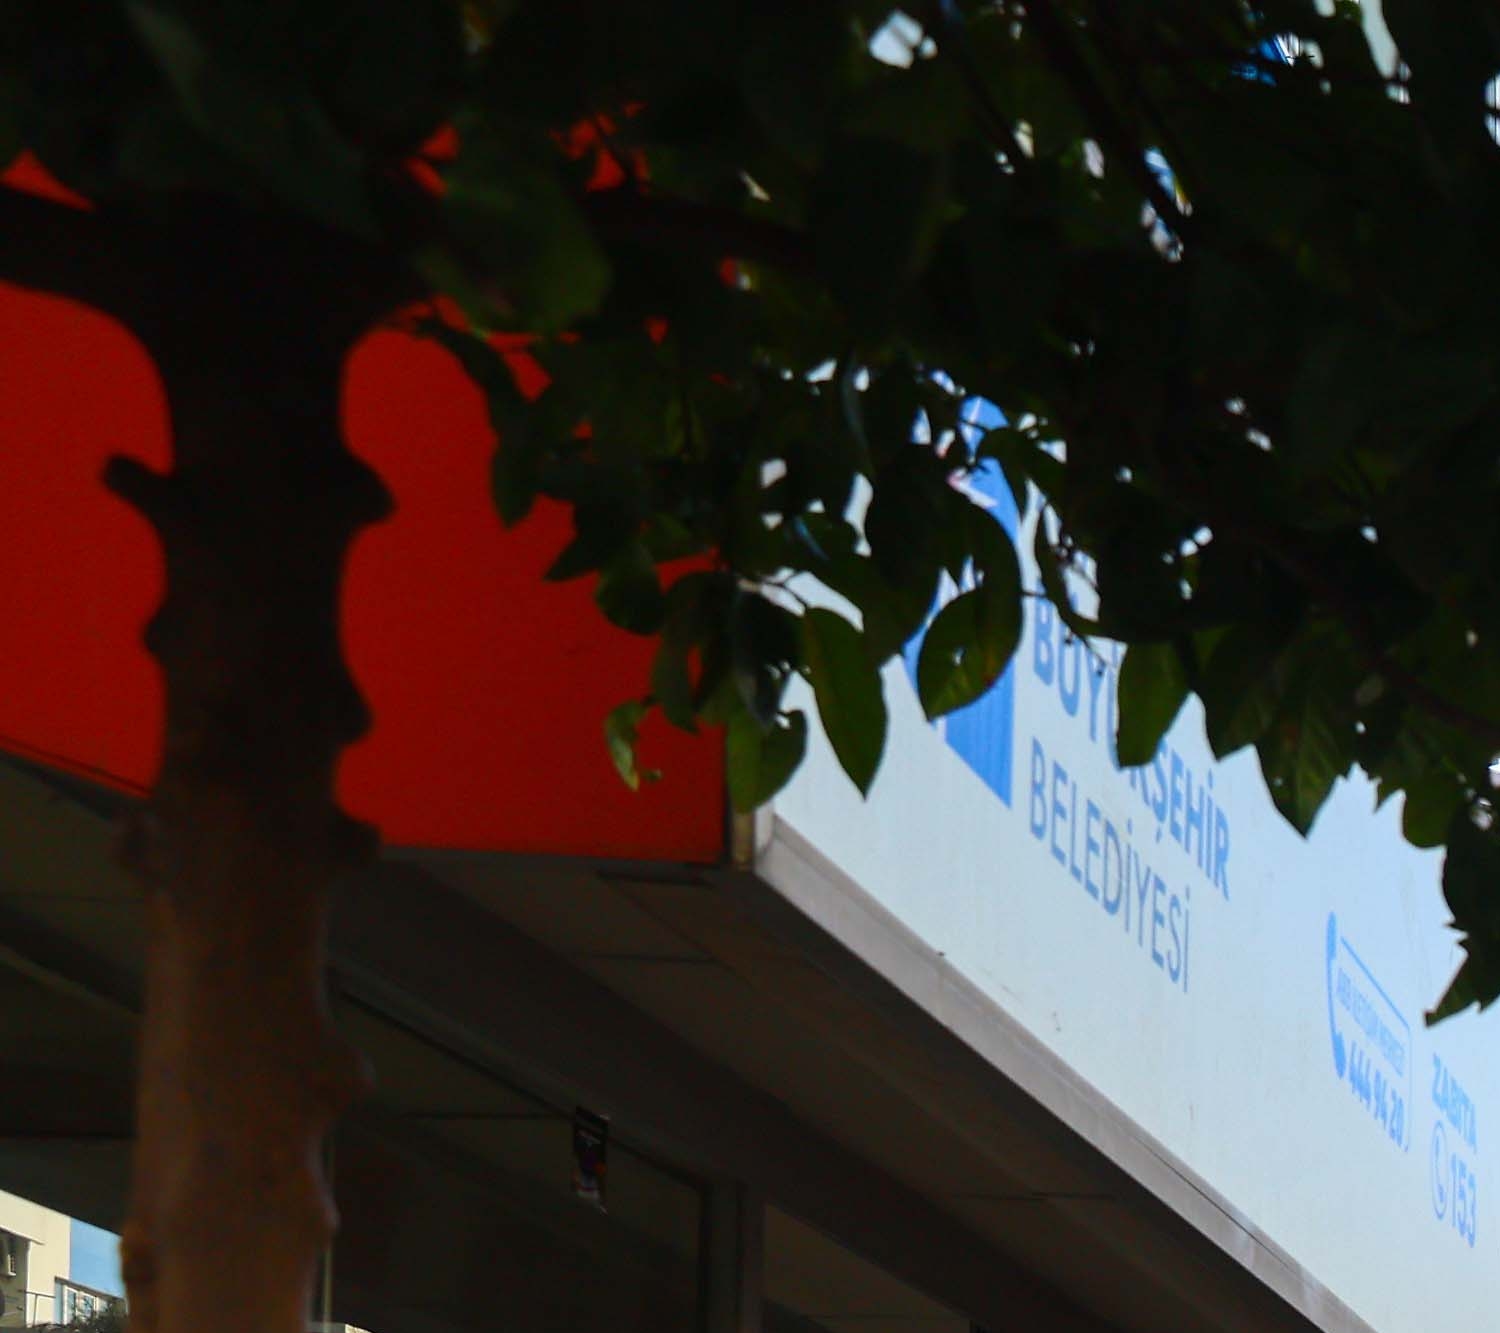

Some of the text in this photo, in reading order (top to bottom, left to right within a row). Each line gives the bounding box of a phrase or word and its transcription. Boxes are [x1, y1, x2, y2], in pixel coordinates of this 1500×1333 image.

[1030, 736, 1190, 994] BELEDİYESİ
[1432, 1052, 1477, 1154] ZABITA
[1451, 1153, 1477, 1249] 153
